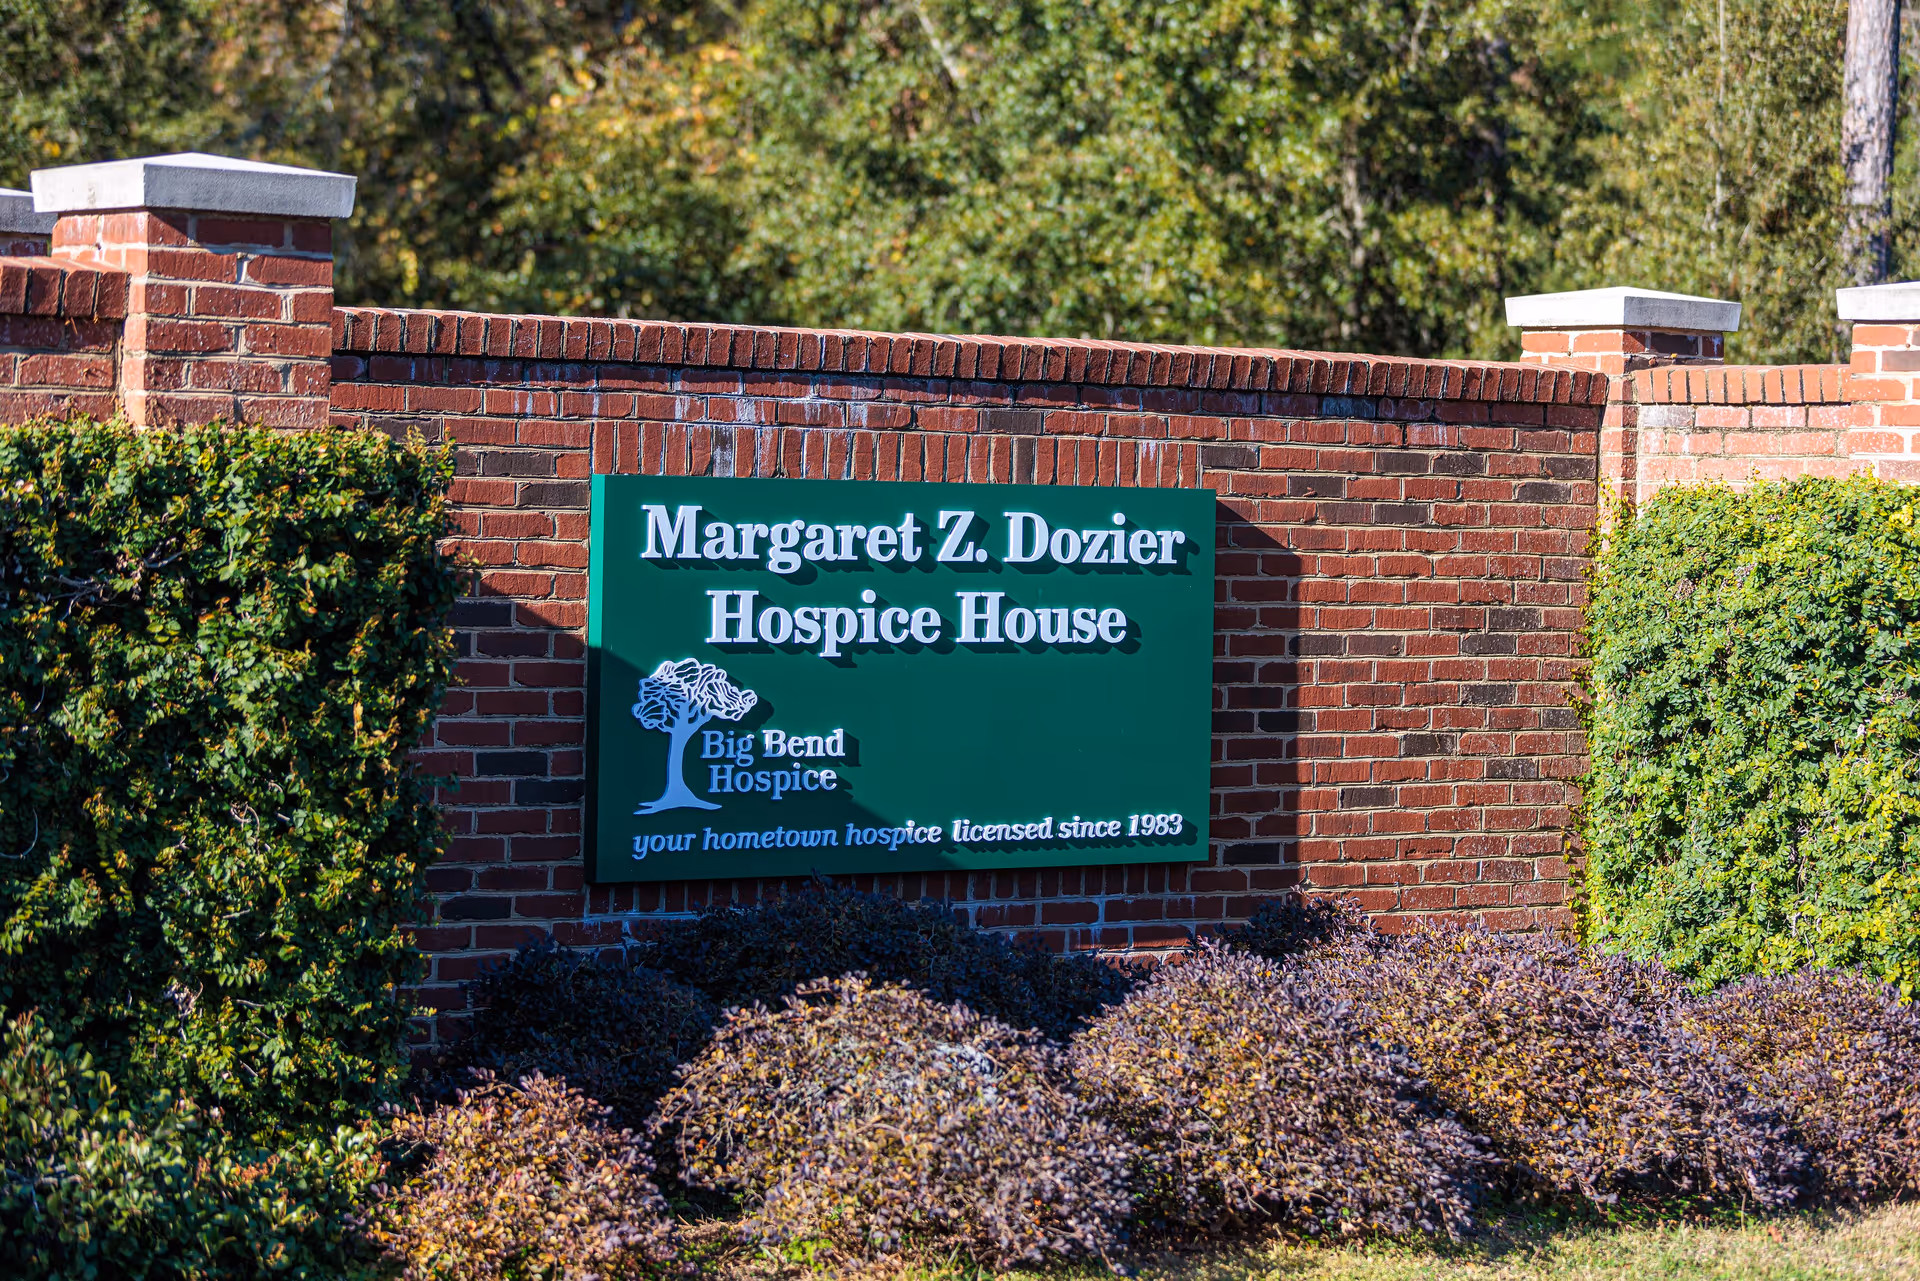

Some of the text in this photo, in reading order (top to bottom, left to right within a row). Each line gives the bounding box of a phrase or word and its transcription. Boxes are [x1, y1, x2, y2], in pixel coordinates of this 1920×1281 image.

[639, 503, 1186, 575] Margaret Z. Dozier
[704, 588, 1127, 658] Hospice House
[702, 727, 846, 767] Big Bend
[709, 762, 838, 800] Hospice
[633, 813, 1184, 860] your hometown hospice licensed since 1983
